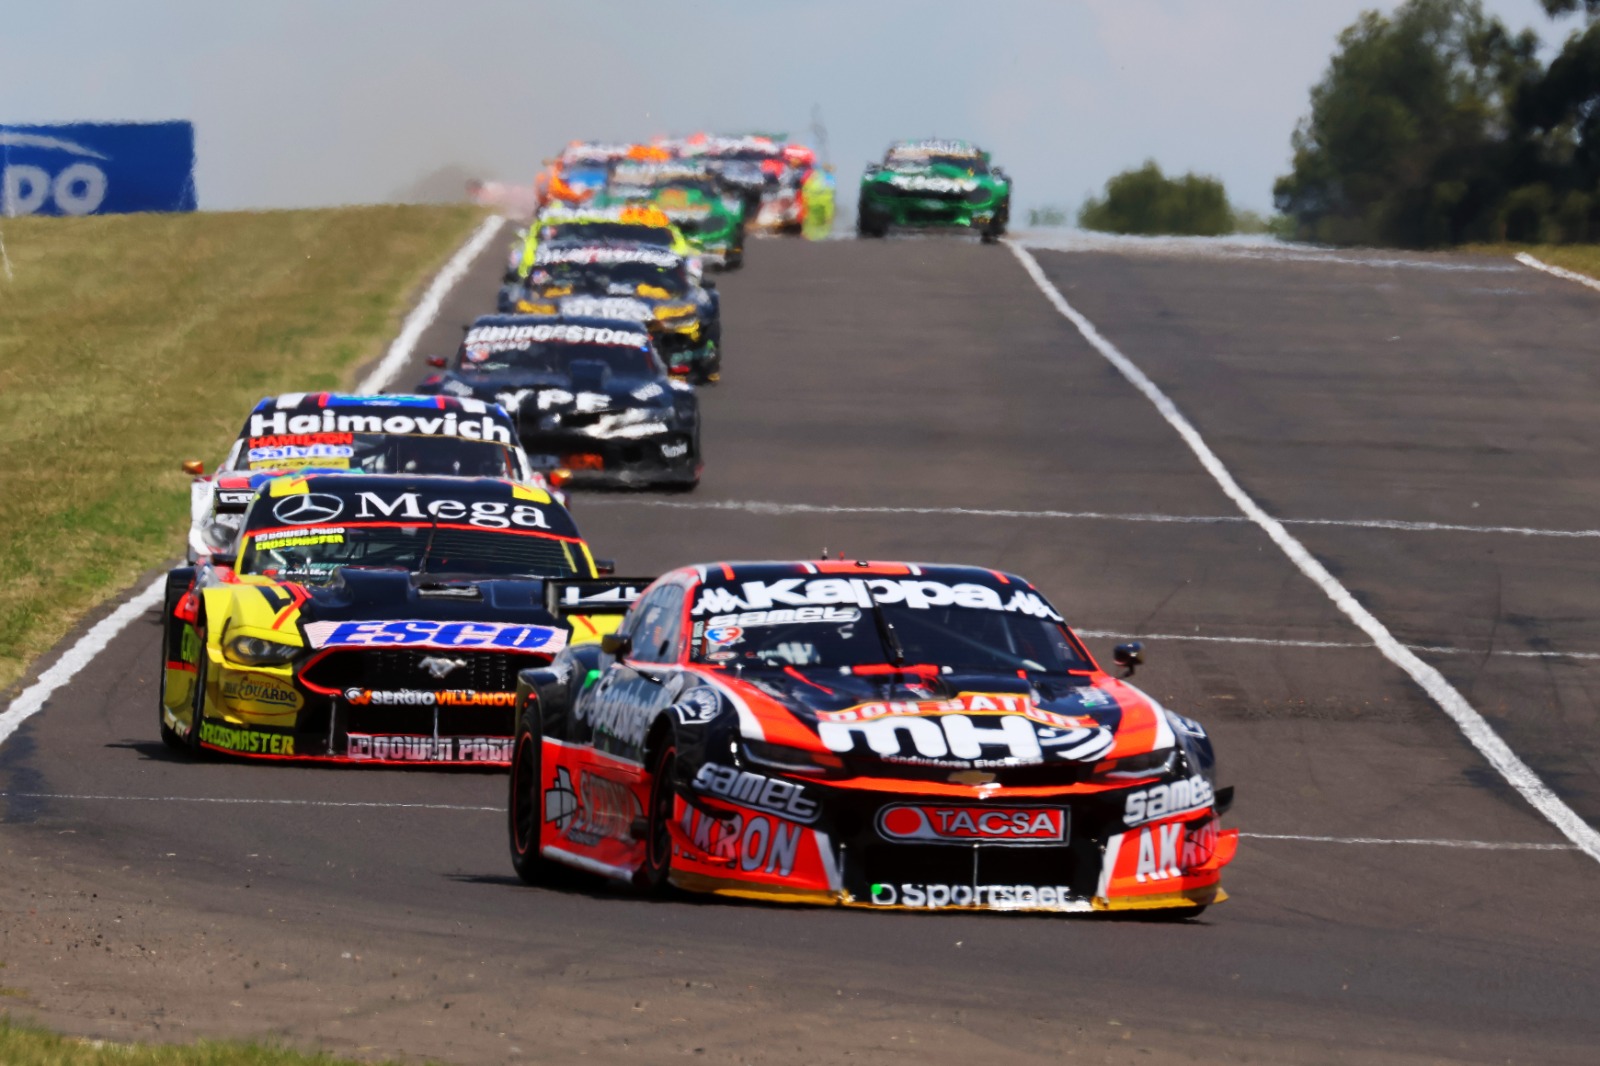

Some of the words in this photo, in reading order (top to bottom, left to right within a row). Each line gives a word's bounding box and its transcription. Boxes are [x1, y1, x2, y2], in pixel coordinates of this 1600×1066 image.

[250, 409, 510, 444] Haimovich
[249, 433, 353, 449] HAMILTON
[355, 491, 552, 529] Mega
[742, 579, 1004, 609] Kappa
[708, 606, 859, 627] samet
[323, 621, 554, 648] ESCO
[371, 690, 435, 705] SERGIO
[435, 691, 517, 706] VILLANOV
[828, 701, 920, 722] DON
[692, 762, 818, 819] samet
[936, 810, 1056, 834] TACSA
